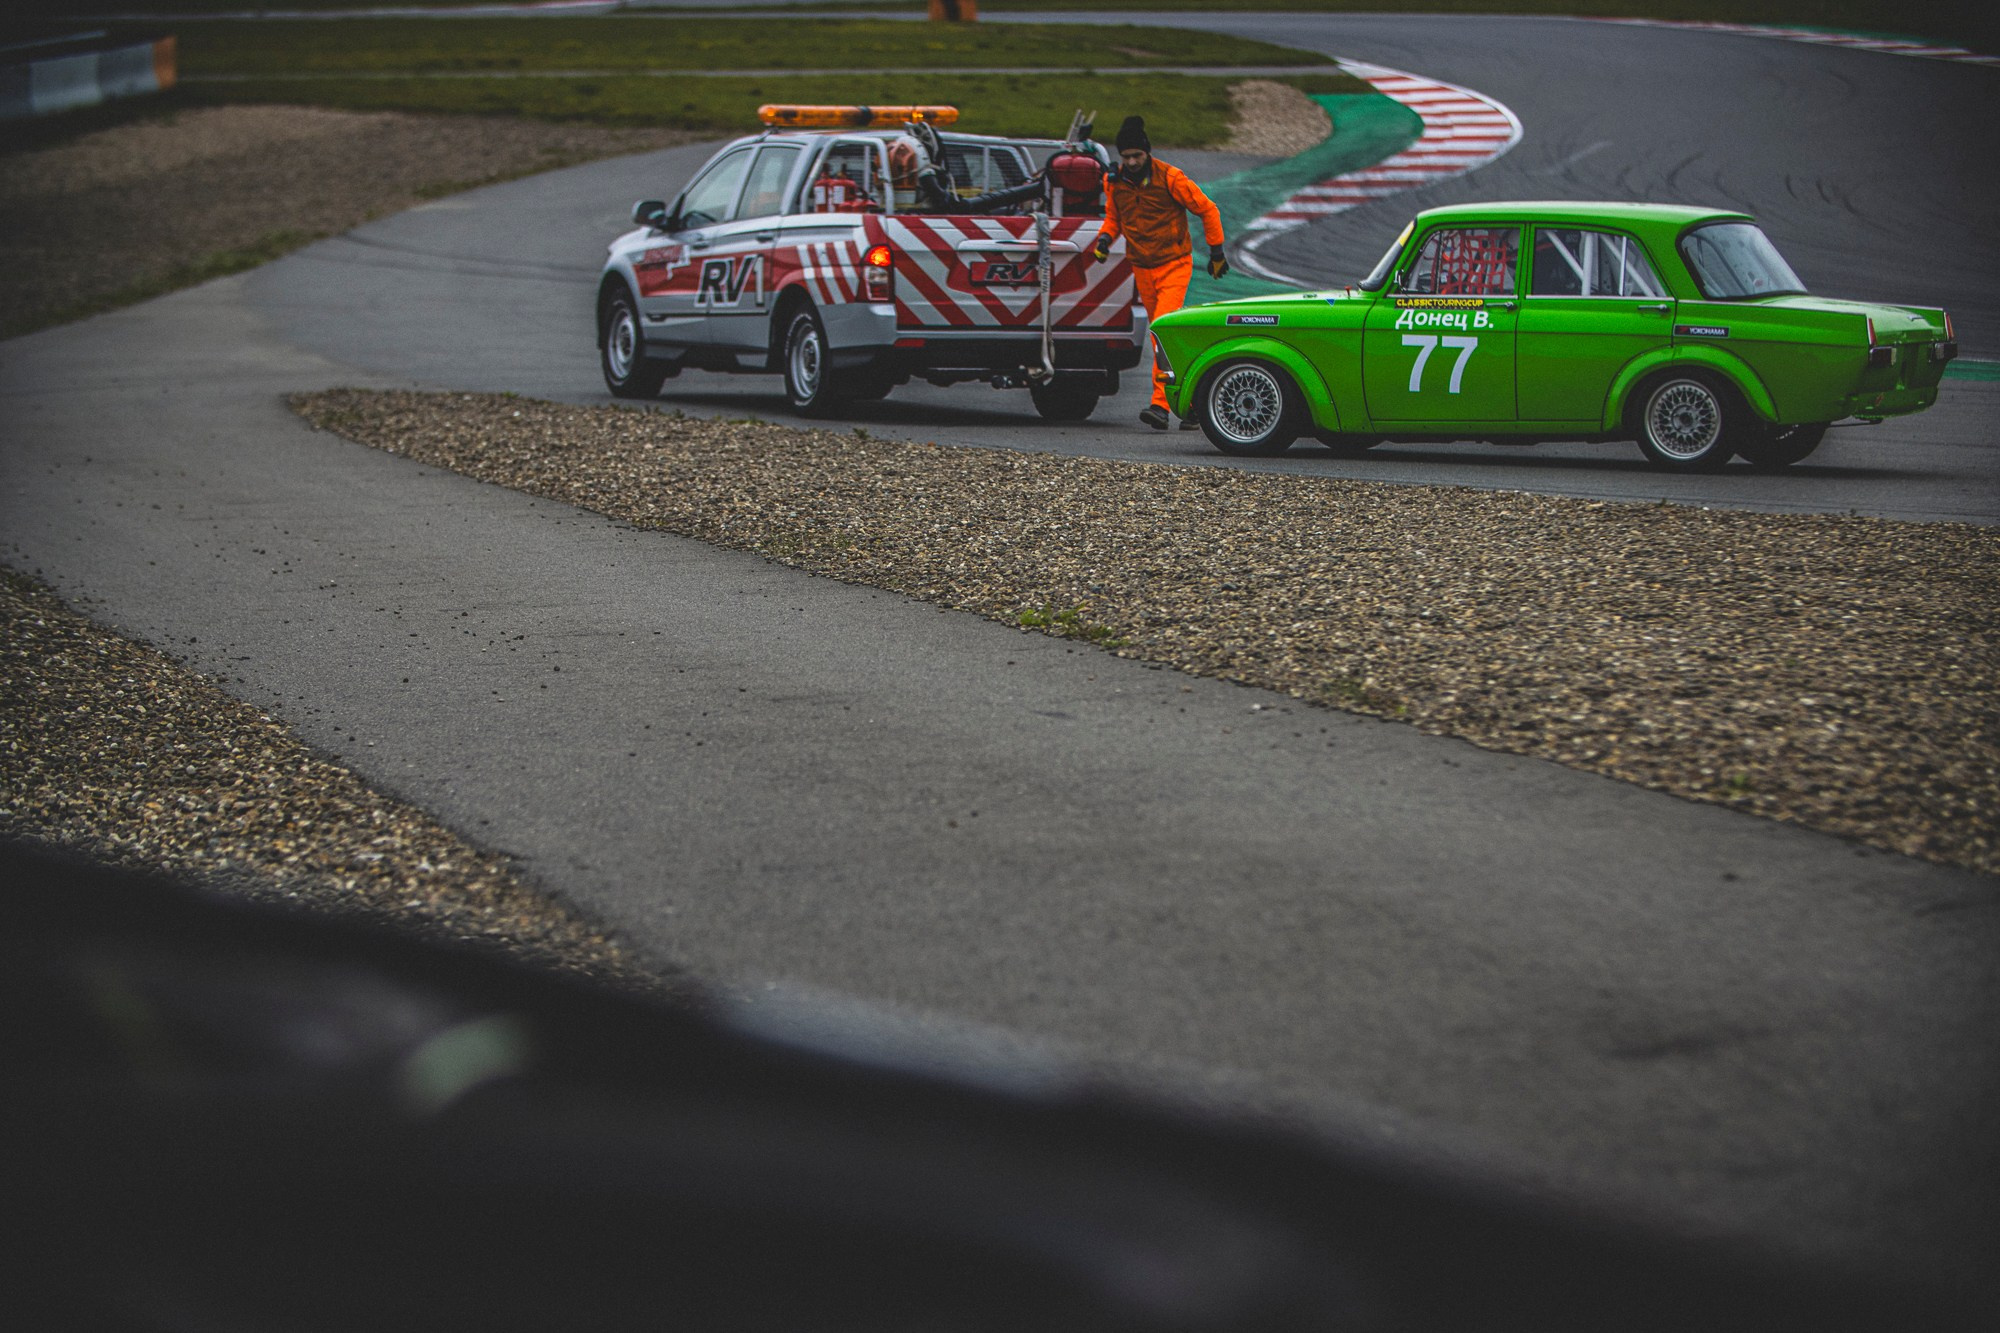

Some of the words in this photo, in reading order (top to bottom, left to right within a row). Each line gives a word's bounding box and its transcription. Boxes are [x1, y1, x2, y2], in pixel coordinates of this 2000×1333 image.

[693, 253, 765, 308] RV1
[1240, 316, 1275, 324] YOKOHAMA
[1395, 309, 1468, 331] Донец
[1473, 311, 1494, 328] В.
[1689, 327, 1725, 336] YOKOHAMA
[1401, 334, 1478, 394] 77
